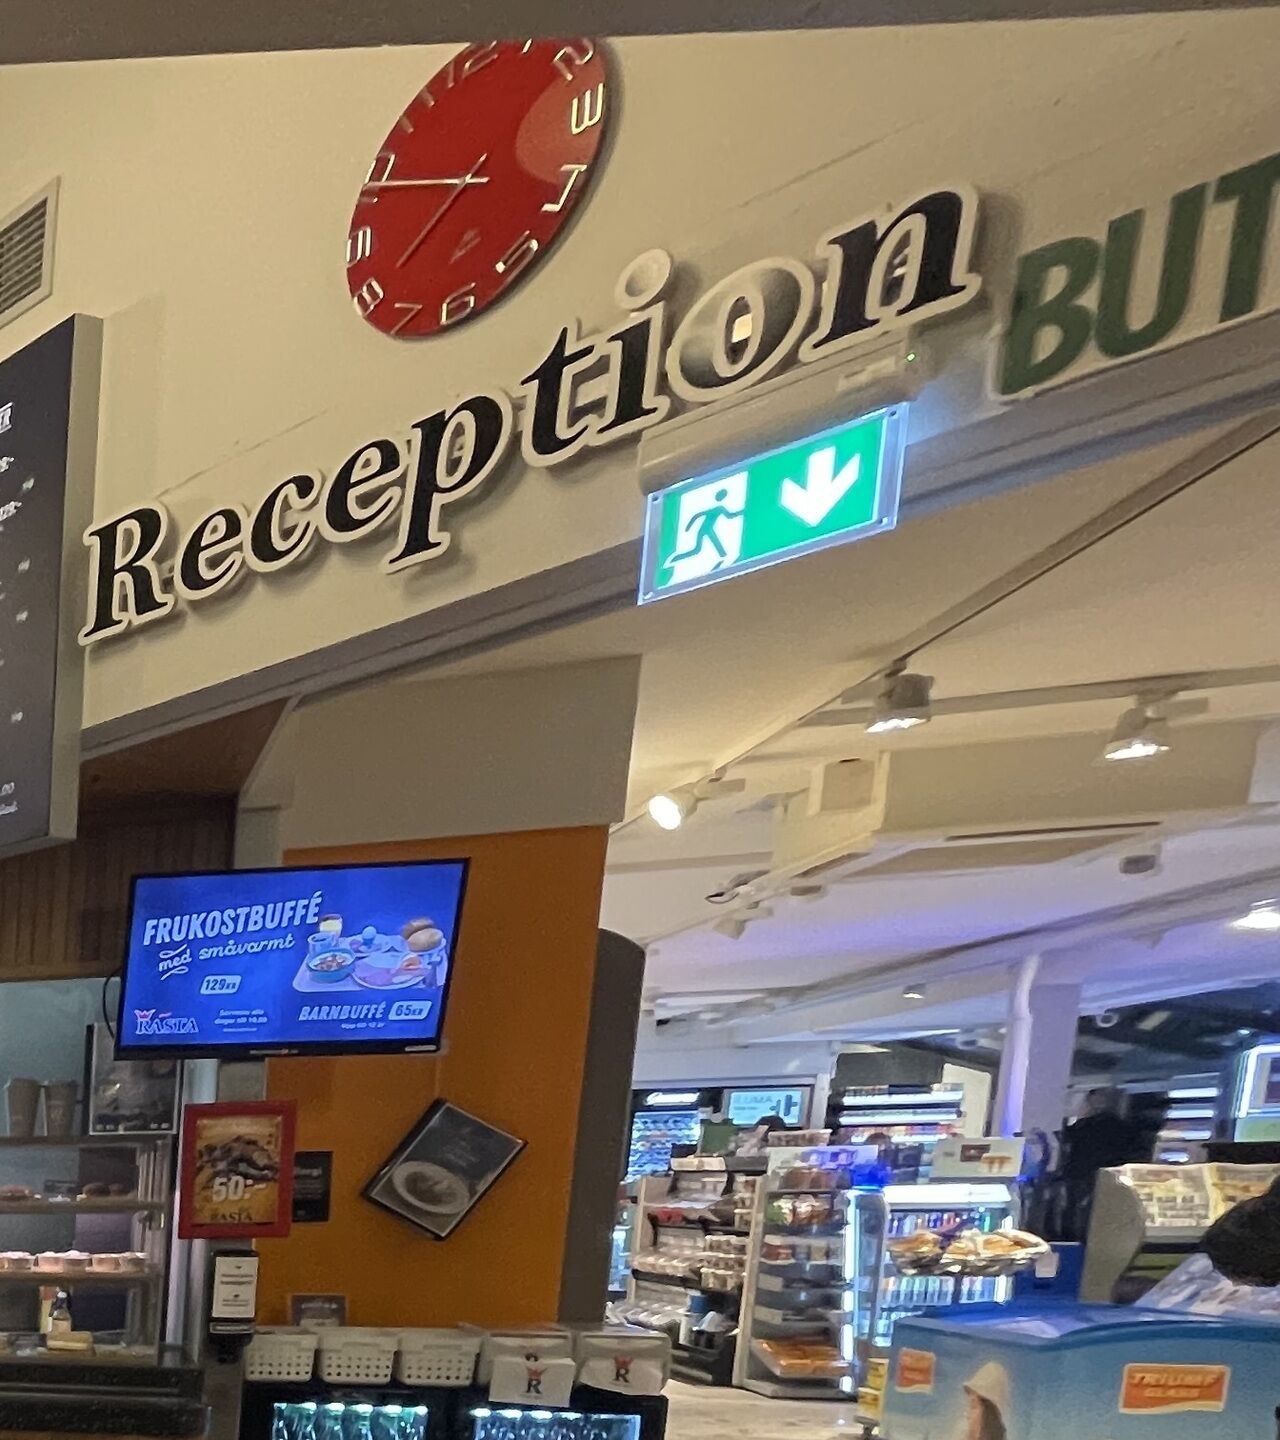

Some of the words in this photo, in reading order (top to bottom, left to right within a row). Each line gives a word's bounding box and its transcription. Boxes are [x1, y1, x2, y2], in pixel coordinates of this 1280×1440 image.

[80, 183, 980, 643] Reception
[143, 890, 323, 946] FRUKOSTBUFFÉ
[158, 946, 193, 974] med
[198, 932, 296, 960] småvarmt
[135, 1017, 200, 1035] RASTA
[298, 1001, 387, 1021] BARNBUFFÉ
[212, 1175, 267, 1203] 50:-
